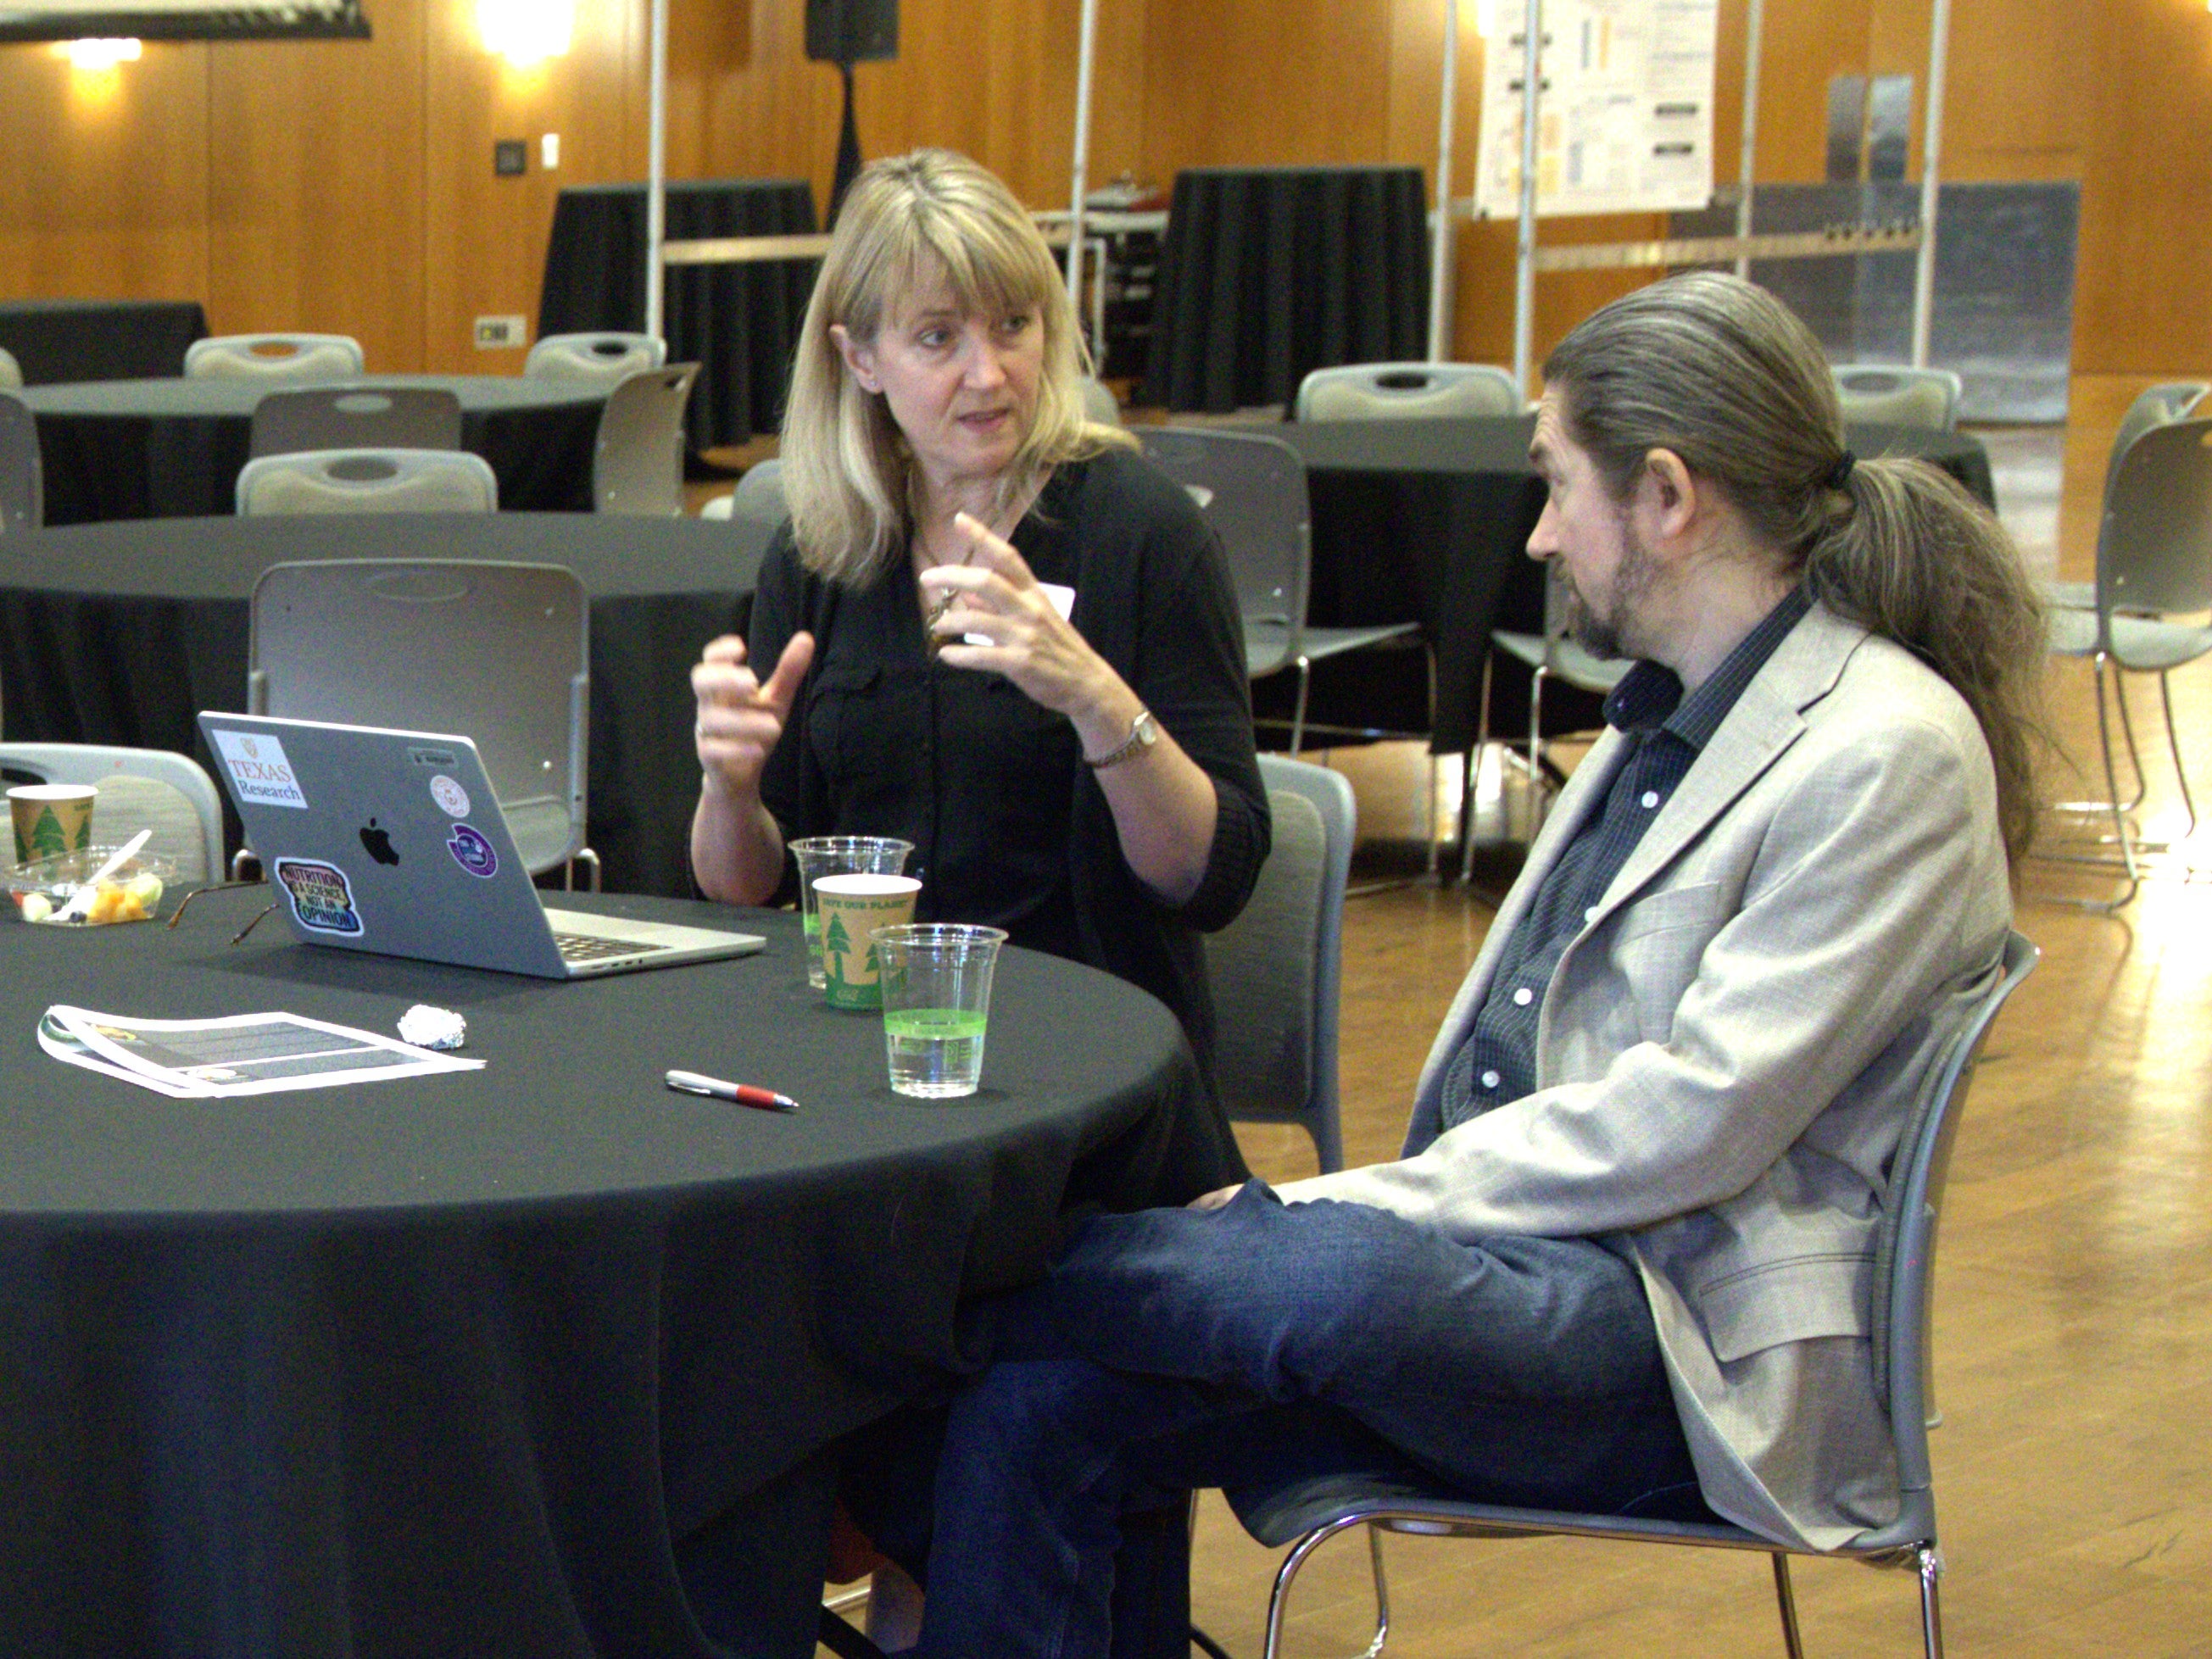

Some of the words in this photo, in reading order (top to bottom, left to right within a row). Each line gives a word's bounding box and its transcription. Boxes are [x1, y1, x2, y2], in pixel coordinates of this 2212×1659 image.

[228, 760, 291, 782] TEXAS
[238, 780, 301, 800] Research
[286, 866, 343, 888] NUTRITION
[305, 895, 322, 907] NOT
[324, 899, 336, 910] AN
[302, 905, 350, 926] OPINION
